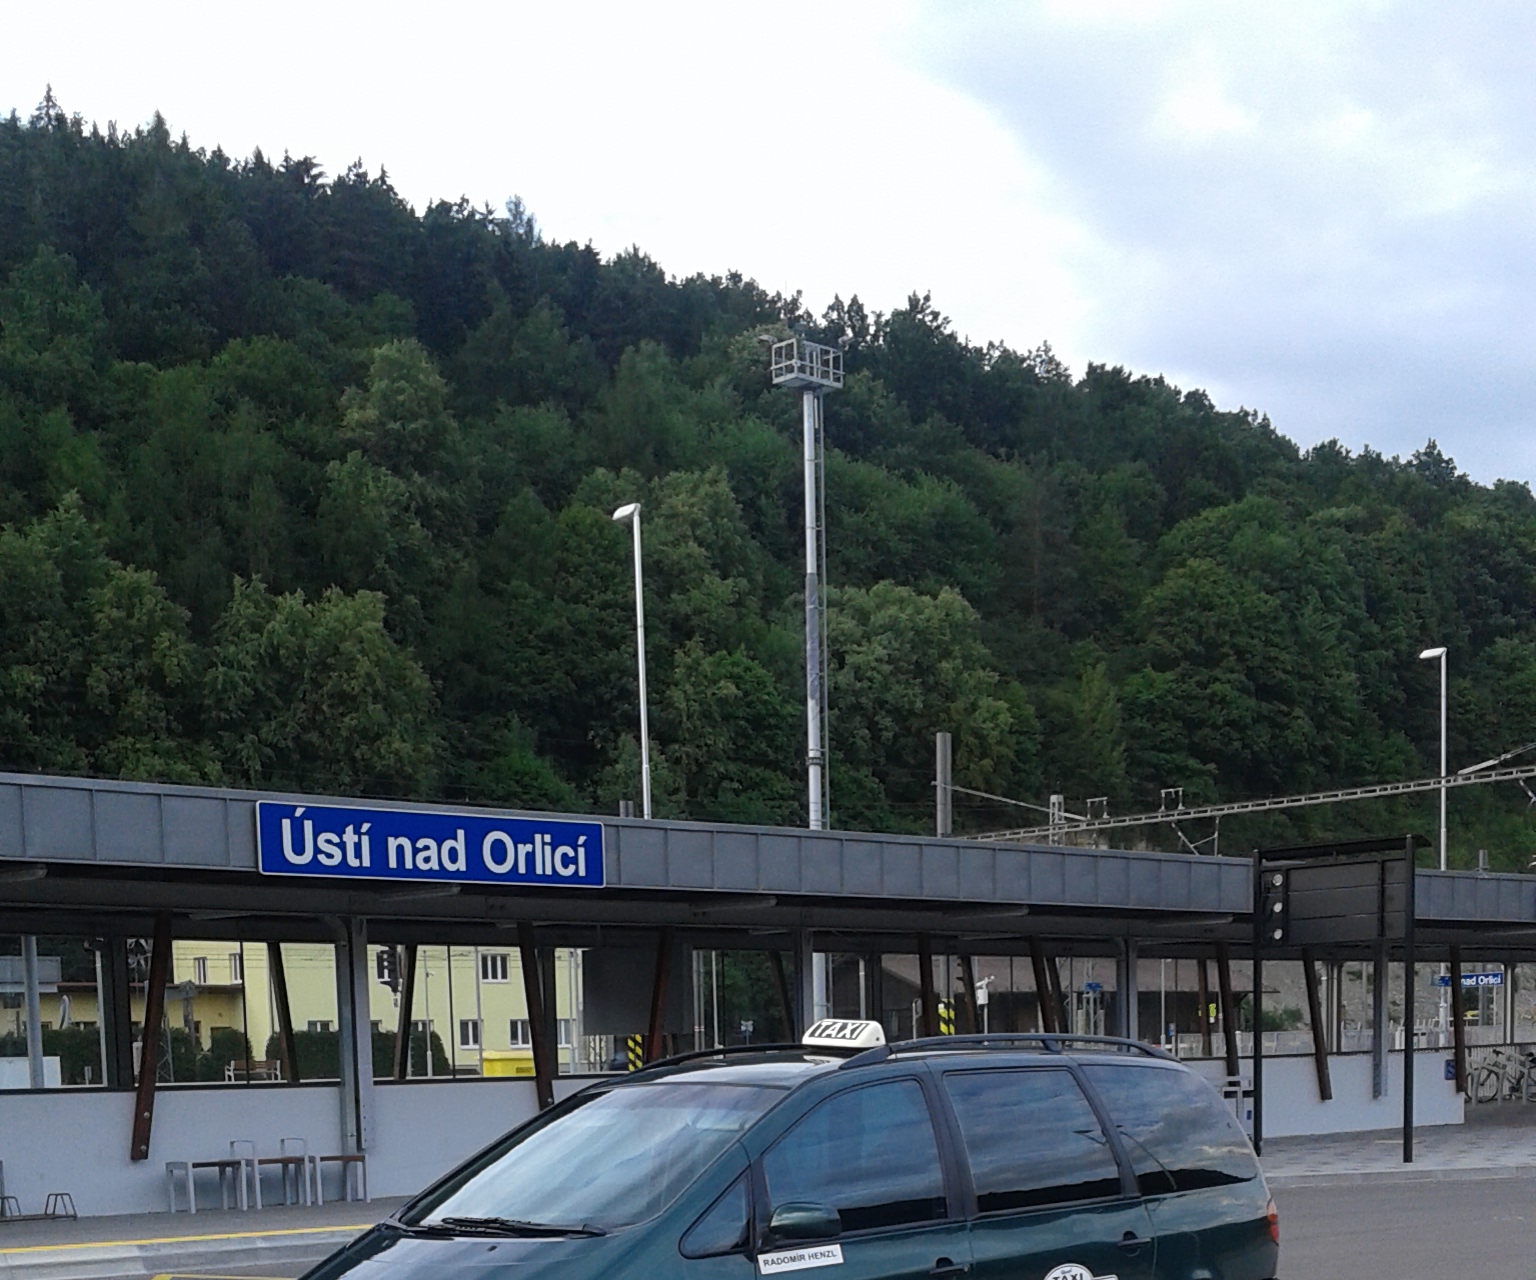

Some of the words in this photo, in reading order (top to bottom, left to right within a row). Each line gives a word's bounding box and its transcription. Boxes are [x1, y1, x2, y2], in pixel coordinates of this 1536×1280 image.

[281, 807, 371, 867] Ústí
[387, 829, 467, 872] nad
[482, 830, 587, 877] Orlicí
[814, 1021, 866, 1040] TAXI
[807, 1250, 837, 1261] HENZL
